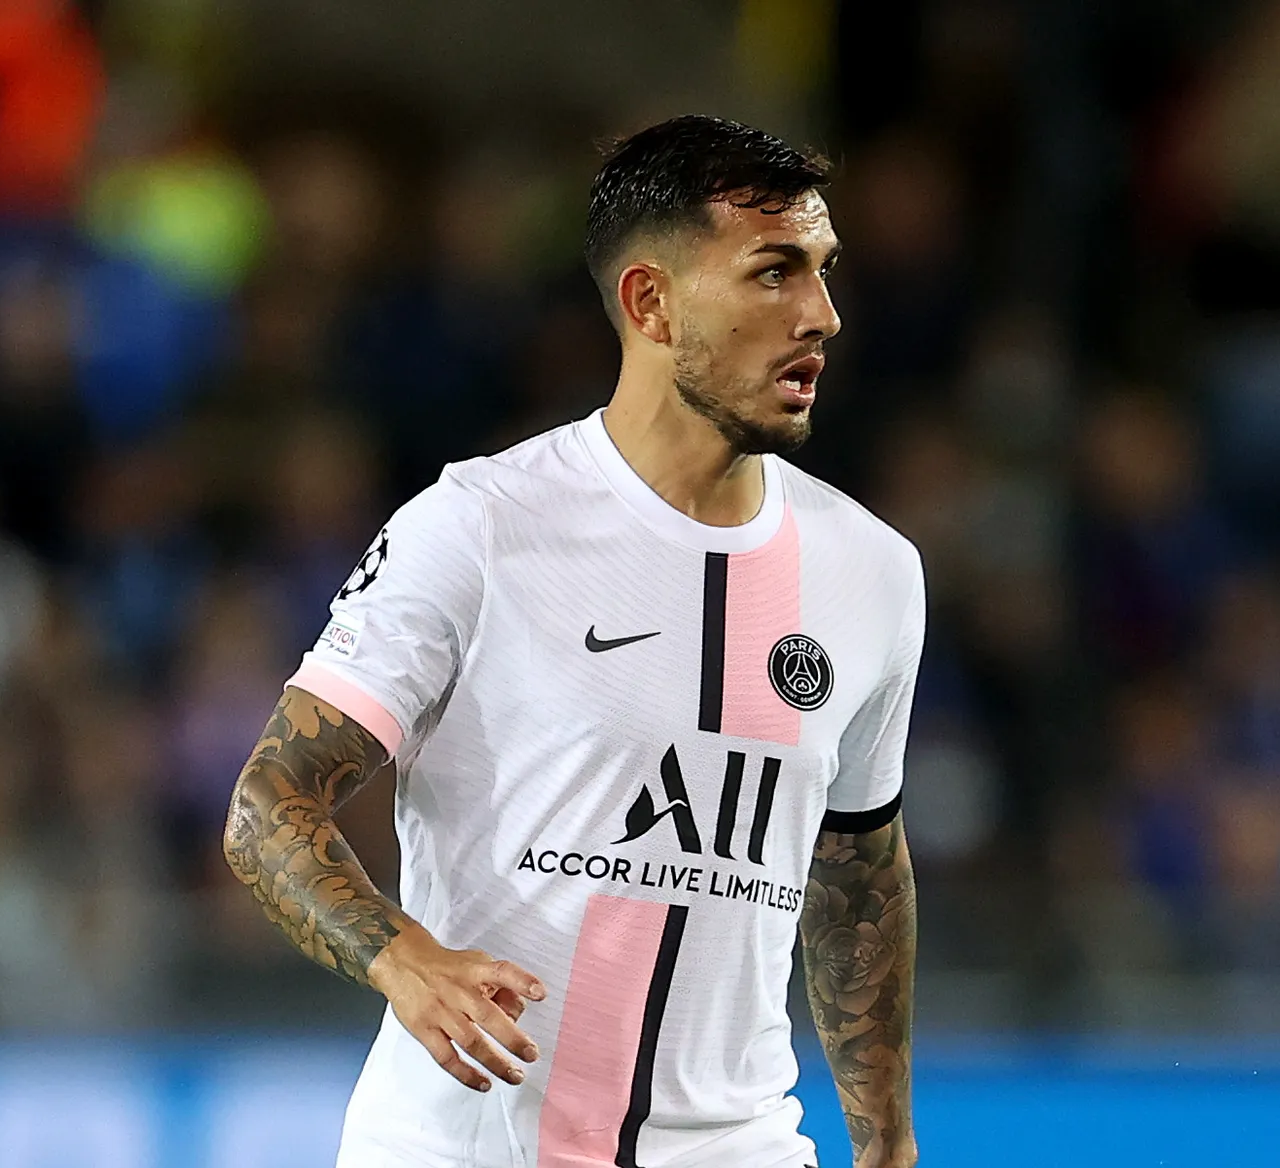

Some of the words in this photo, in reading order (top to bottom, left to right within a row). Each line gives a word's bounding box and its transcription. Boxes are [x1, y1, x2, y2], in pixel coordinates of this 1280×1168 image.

[780, 640, 821, 660] PARIS
[517, 847, 632, 884] ACCOR
[640, 862, 703, 893] LIVE
[709, 871, 802, 913] LIMITLESS
